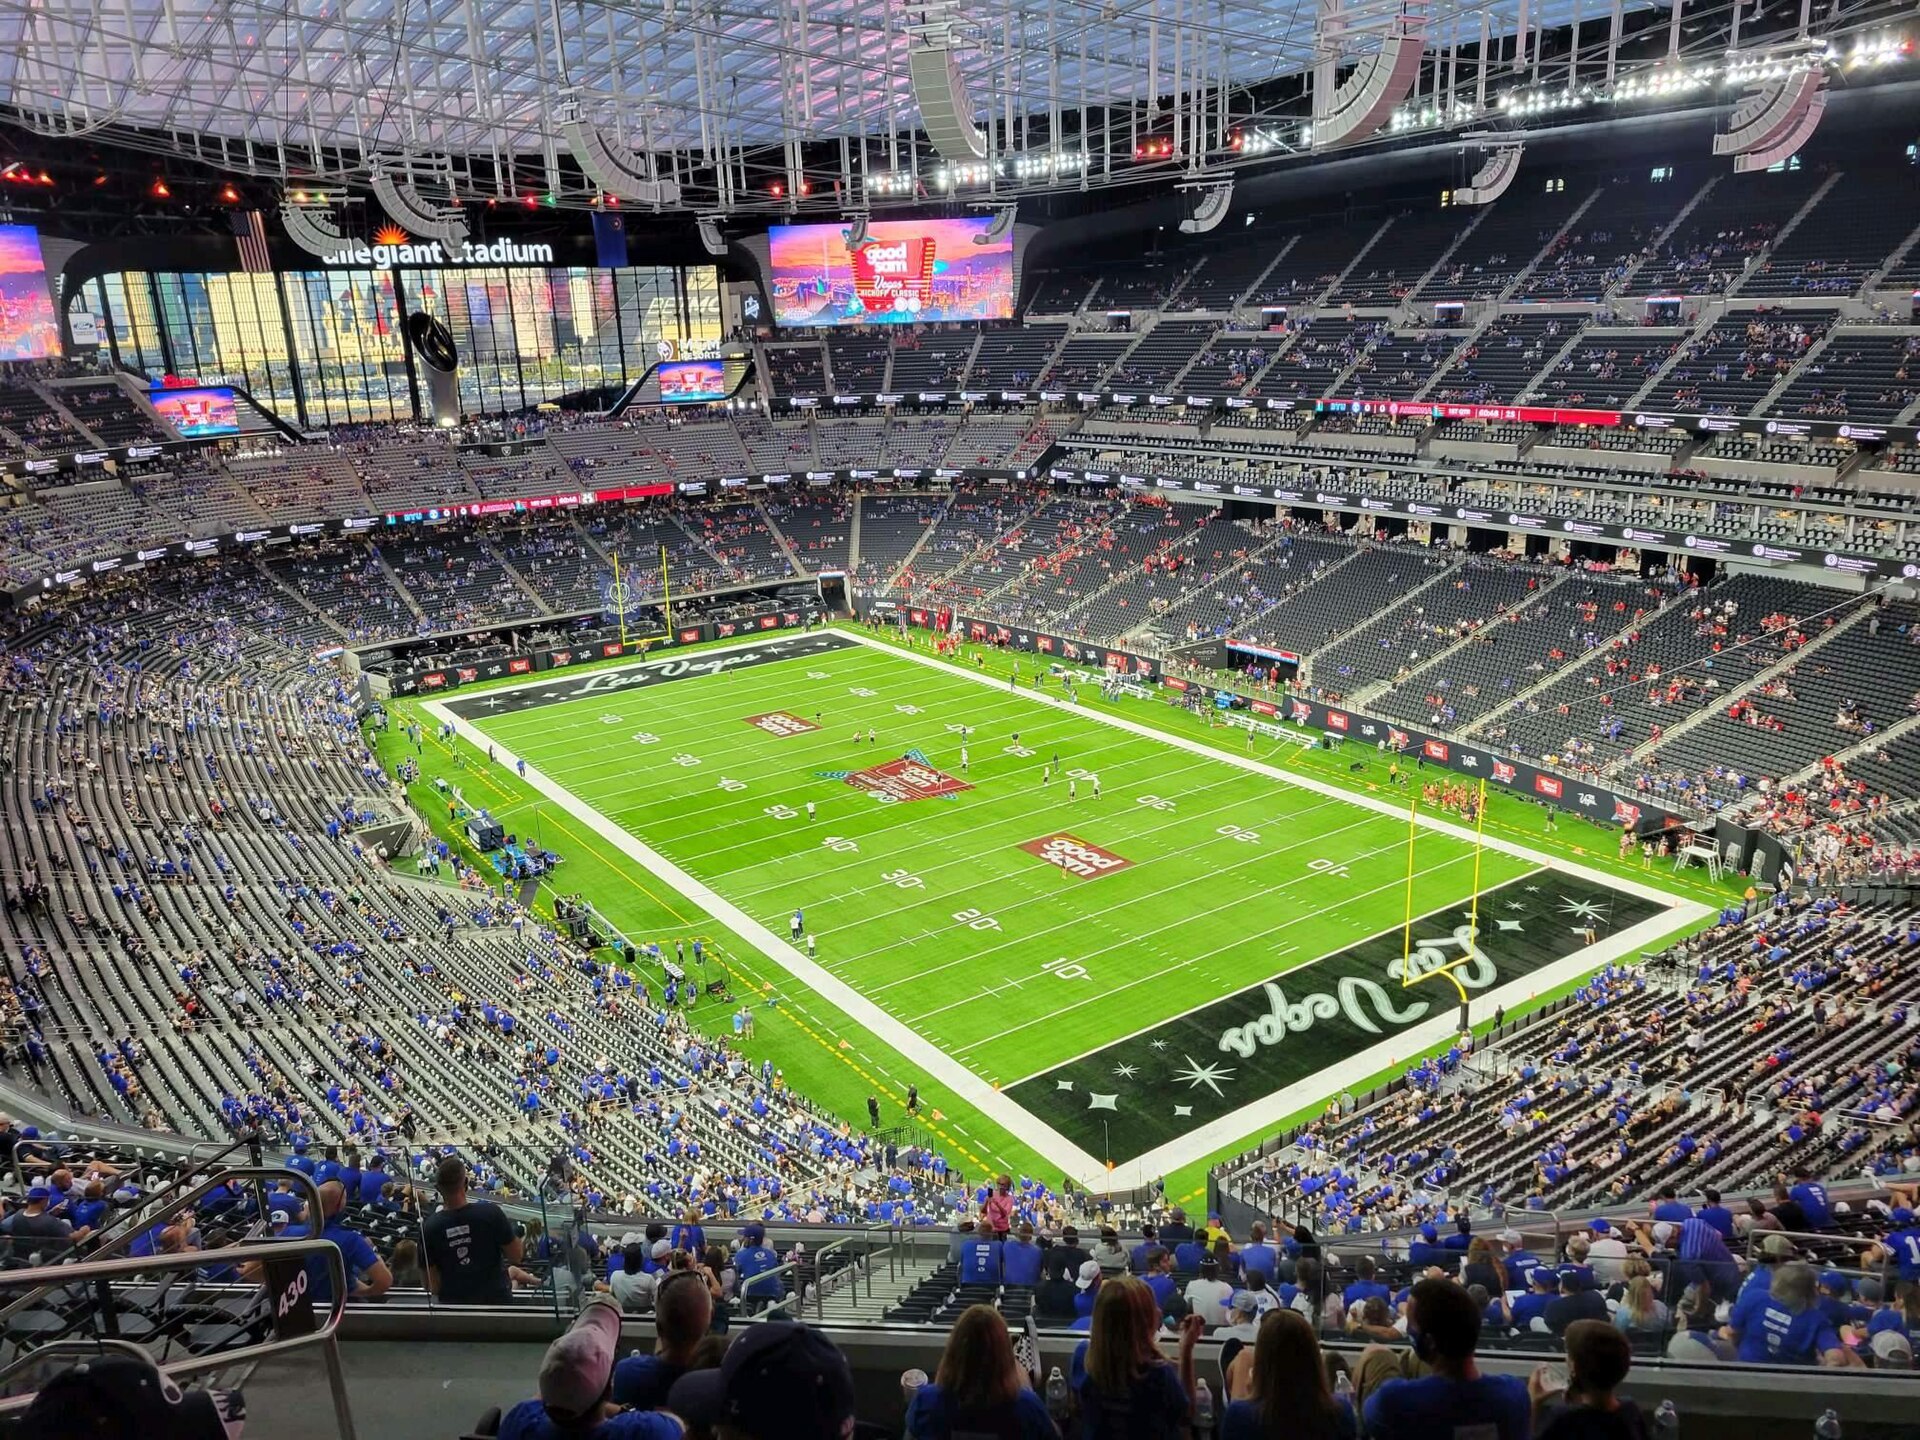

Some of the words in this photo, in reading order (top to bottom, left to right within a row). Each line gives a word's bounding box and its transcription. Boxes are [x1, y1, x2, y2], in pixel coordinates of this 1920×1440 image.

[452, 237, 553, 263] tadium
[866, 242, 907, 265] good
[874, 260, 907, 273] sam
[198, 375, 229, 386] LIGHT
[606, 602, 638, 614] Allsate
[570, 673, 650, 696] Las
[647, 653, 762, 676] Vegas
[762, 715, 815, 732] good
[763, 804, 799, 820] 50
[1136, 794, 1174, 811] 30
[1216, 824, 1259, 842] 20
[821, 836, 857, 852] 40
[1042, 839, 1124, 869] good
[1307, 858, 1346, 877] 10
[881, 868, 922, 889] 30
[951, 908, 998, 931] 20
[1387, 925, 1498, 988] Las
[1041, 957, 1087, 980] 10
[1218, 976, 1430, 1058] Vegas
[278, 1269, 308, 1318] 430
